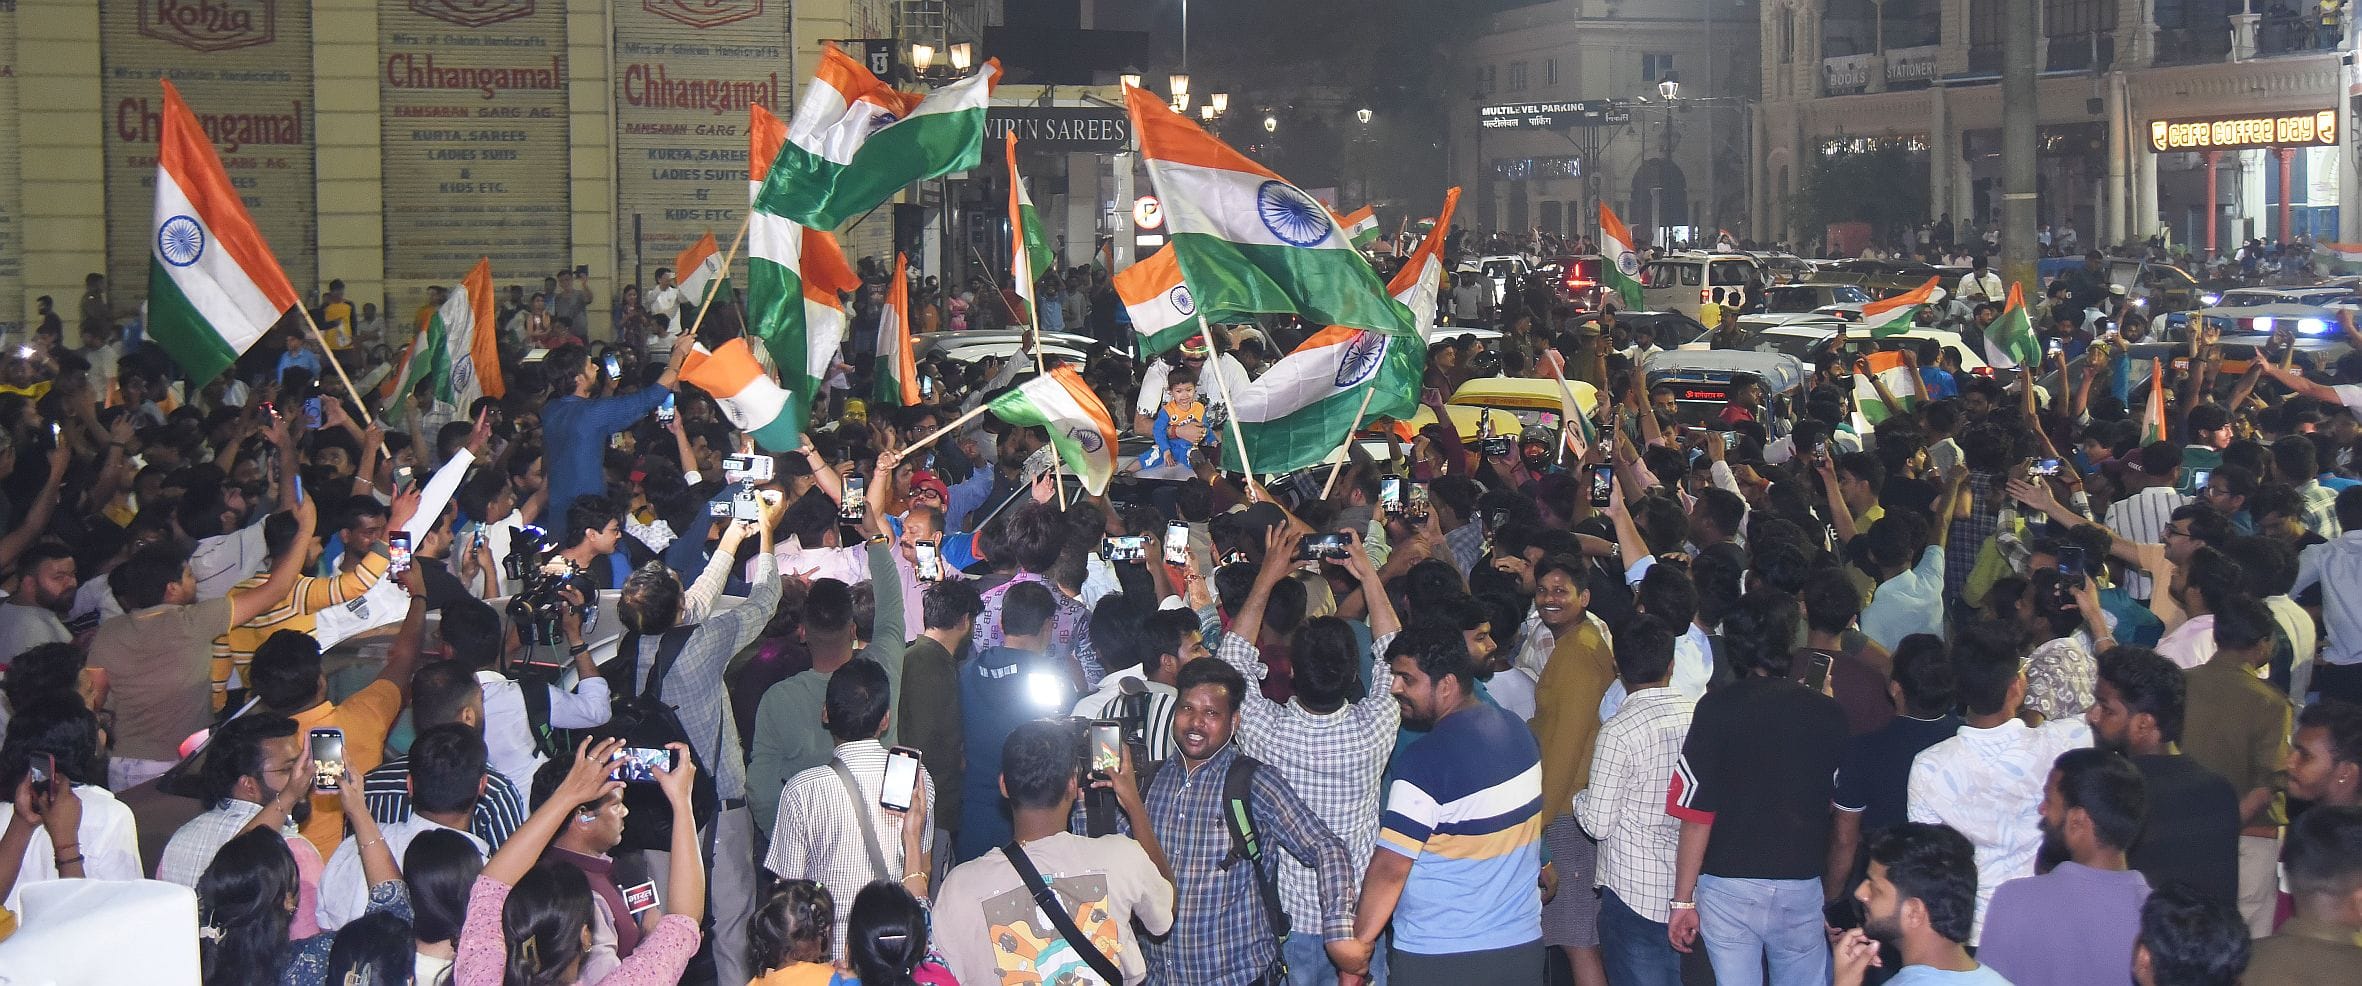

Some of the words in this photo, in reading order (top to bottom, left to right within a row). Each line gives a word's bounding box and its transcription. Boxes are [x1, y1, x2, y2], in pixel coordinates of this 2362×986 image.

[1886, 61, 1938, 79] STATIONERY
[387, 53, 562, 100] Chhangamal
[1830, 72, 1866, 86] BOOKS
[625, 62, 779, 116] Chhangamal
[478, 107, 522, 118] GARG
[1542, 102, 1585, 113] PARKING
[695, 124, 736, 136] GARG
[1045, 118, 1126, 141] SAREES
[428, 150, 476, 160] LADIES
[481, 150, 517, 160] SUITS
[652, 169, 700, 181] LADIES
[704, 169, 749, 181] SUITS
[440, 183, 474, 194] KIDS
[666, 209, 700, 221] KIDS
